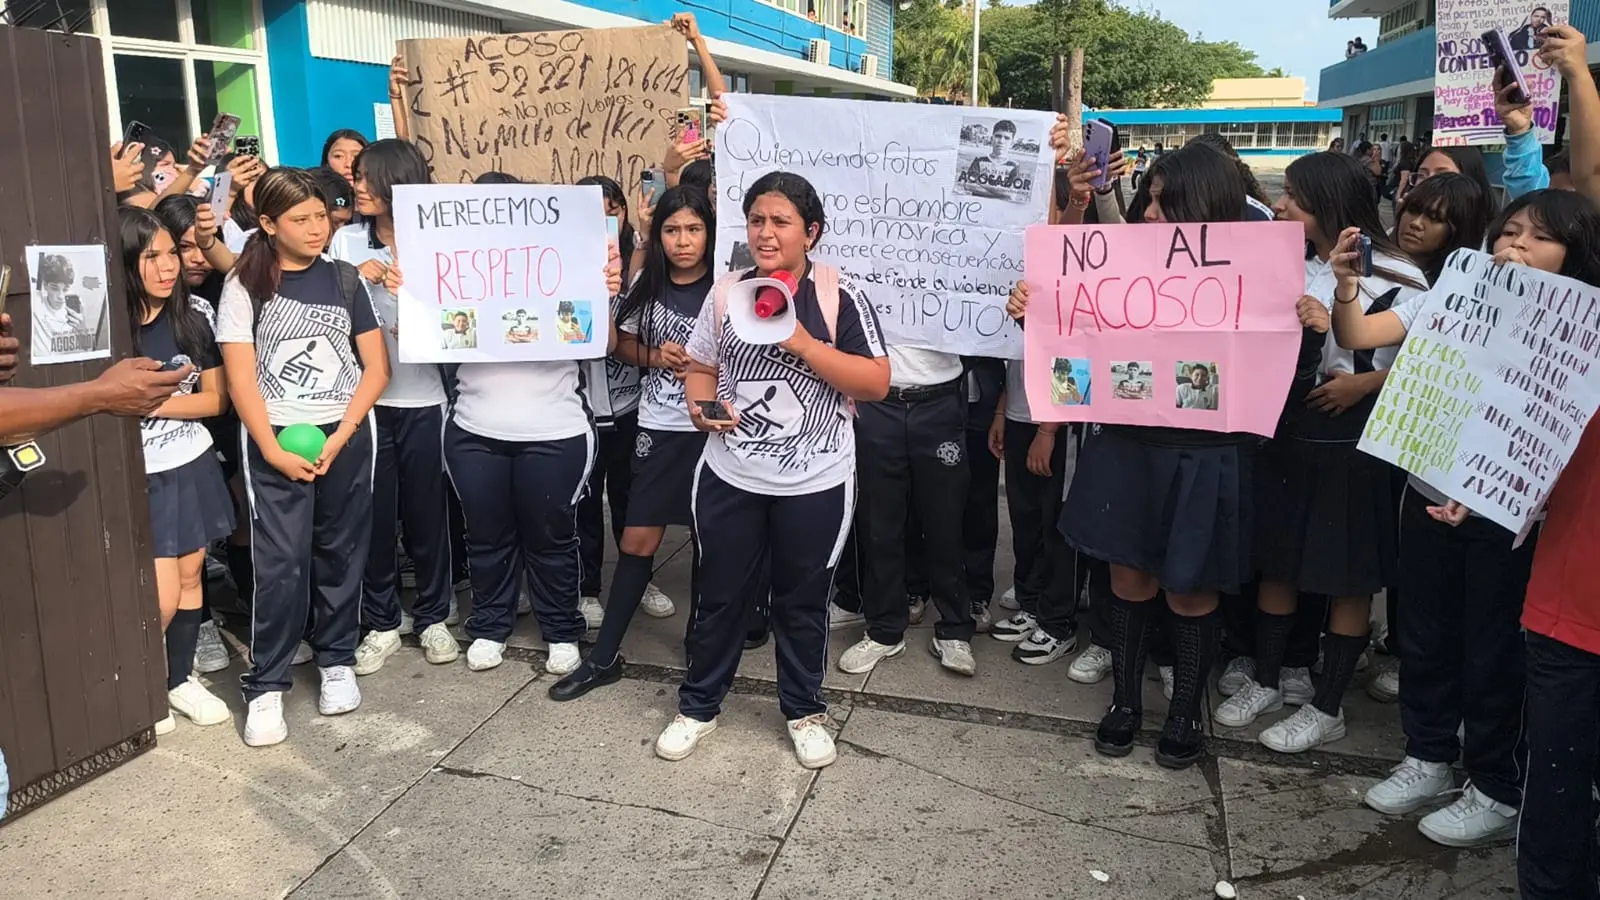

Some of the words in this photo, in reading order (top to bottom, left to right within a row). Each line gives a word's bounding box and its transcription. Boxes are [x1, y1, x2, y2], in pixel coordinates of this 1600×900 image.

[465, 32, 584, 62] ACOSO
[1438, 40, 1457, 58] NO
[544, 101, 573, 118] nos
[724, 118, 804, 166] Quien
[808, 142, 879, 169] vende
[882, 141, 938, 176] fotos
[417, 196, 560, 229] MERECEMOS
[855, 195, 881, 214] es
[884, 183, 981, 223] hombre
[819, 242, 897, 261] merece
[833, 217, 865, 237] un
[870, 218, 968, 246] marica
[984, 231, 1002, 256] y
[1062, 230, 1107, 276] NO
[1165, 224, 1231, 269] AL
[435, 245, 562, 304] RESPETO
[1448, 247, 1476, 273] NO
[953, 275, 1016, 297] violenci
[1055, 274, 1242, 336] ¡ACOSO!
[309, 309, 351, 334] DGES
